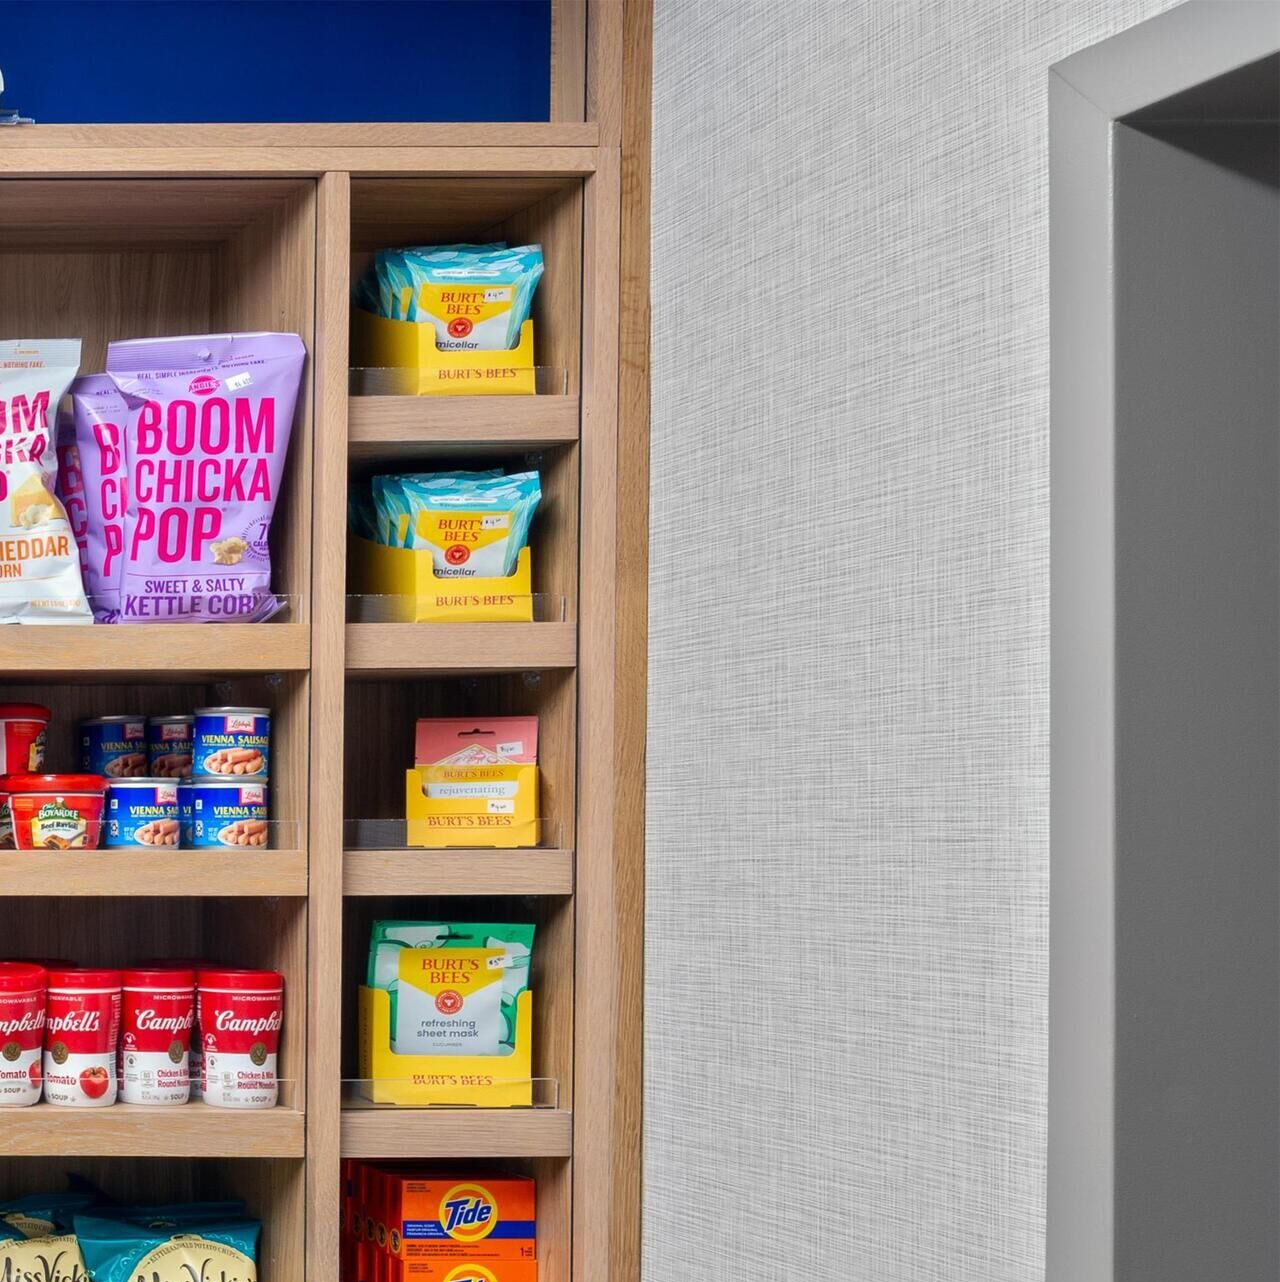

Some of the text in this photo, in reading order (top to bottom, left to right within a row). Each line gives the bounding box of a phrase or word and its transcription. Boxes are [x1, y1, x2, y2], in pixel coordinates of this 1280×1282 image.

[446, 303, 481, 315] BEES
[436, 340, 479, 350] micellar
[136, 397, 276, 456] BOOM
[135, 457, 271, 503] CHICKA
[129, 507, 223, 563] POP
[444, 531, 479, 542] BEES
[433, 567, 476, 577] micellar
[145, 578, 245, 594] SWEET & SALTY
[124, 595, 201, 617] KETTLE
[202, 735, 236, 744] VIENNA
[439, 784, 506, 796] rejuvenating
[130, 806, 165, 816] VIENNA
[213, 806, 248, 816] VIENNA
[427, 815, 512, 827] BURT'S BEES
[421, 958, 479, 971] BURT'S
[430, 971, 470, 984] BEES
[421, 1018, 476, 1030] refreshing
[416, 1029, 479, 1038] sheet mask
[444, 1198, 492, 1232] Tide
